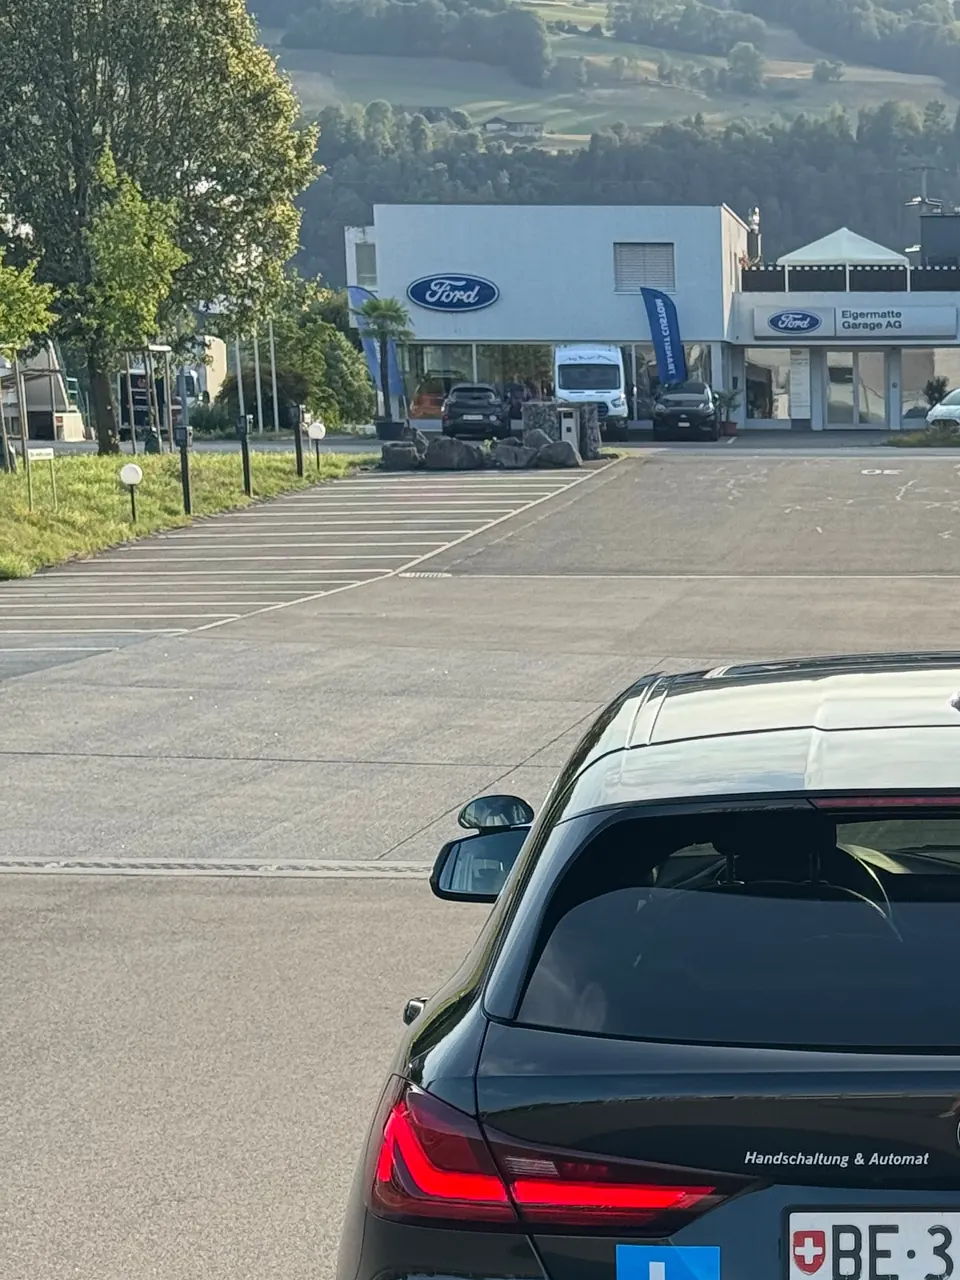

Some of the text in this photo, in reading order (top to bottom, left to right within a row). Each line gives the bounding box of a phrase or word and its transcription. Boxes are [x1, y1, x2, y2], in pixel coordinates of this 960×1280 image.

[425, 279, 480, 303] Ford
[778, 314, 810, 329] Ford
[841, 310, 902, 320] Eigermatte
[842, 320, 902, 331] Garage AG
[744, 1151, 930, 1168] Handschaltung & Automat
